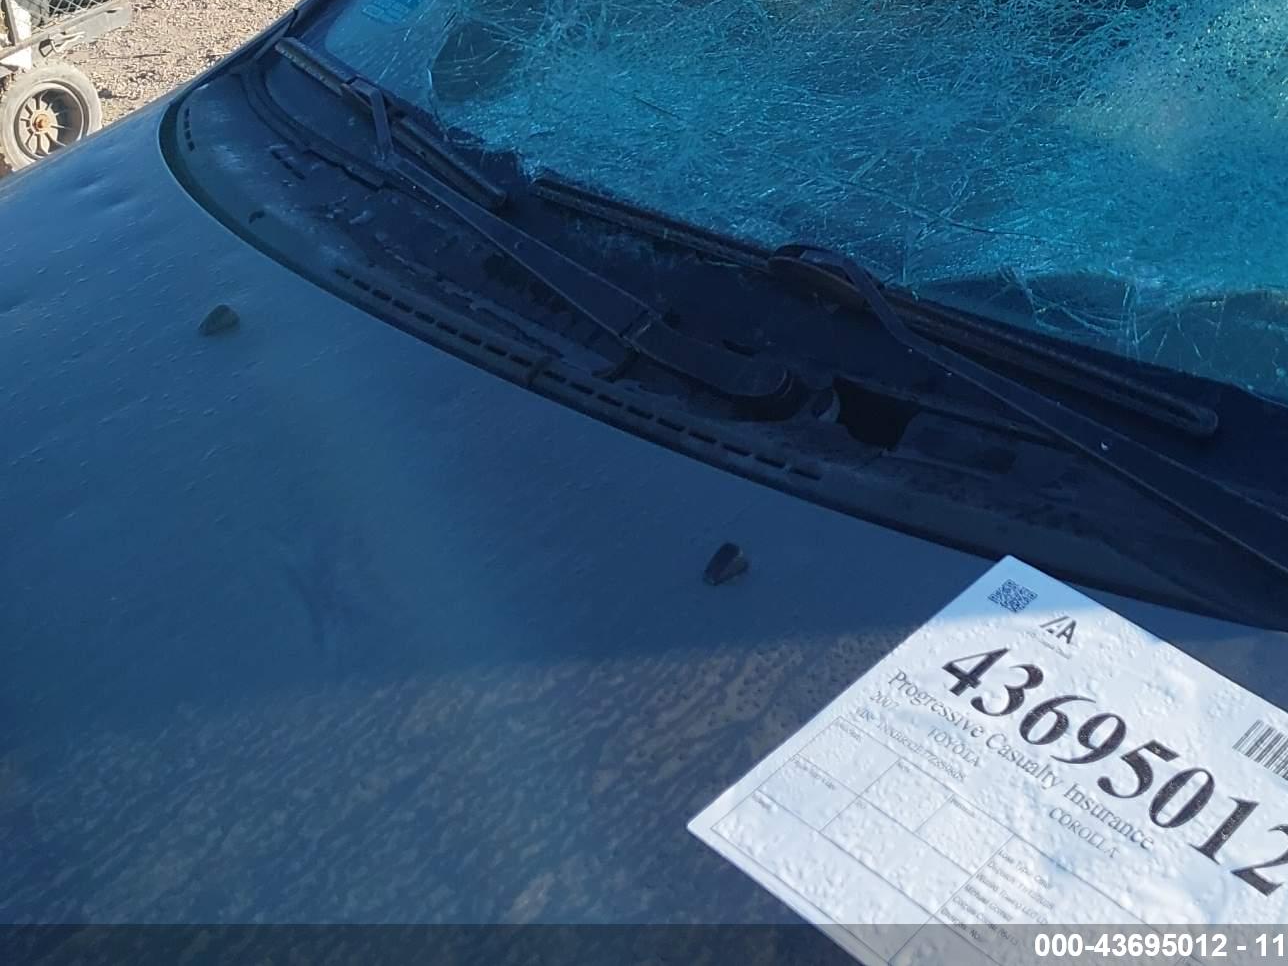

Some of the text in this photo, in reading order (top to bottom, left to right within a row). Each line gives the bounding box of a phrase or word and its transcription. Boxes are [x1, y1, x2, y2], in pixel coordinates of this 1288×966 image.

[870, 690, 1121, 859] 2007 TOYOTA COROLLA
[888, 670, 1155, 851] Progressive Casualty Insurance
